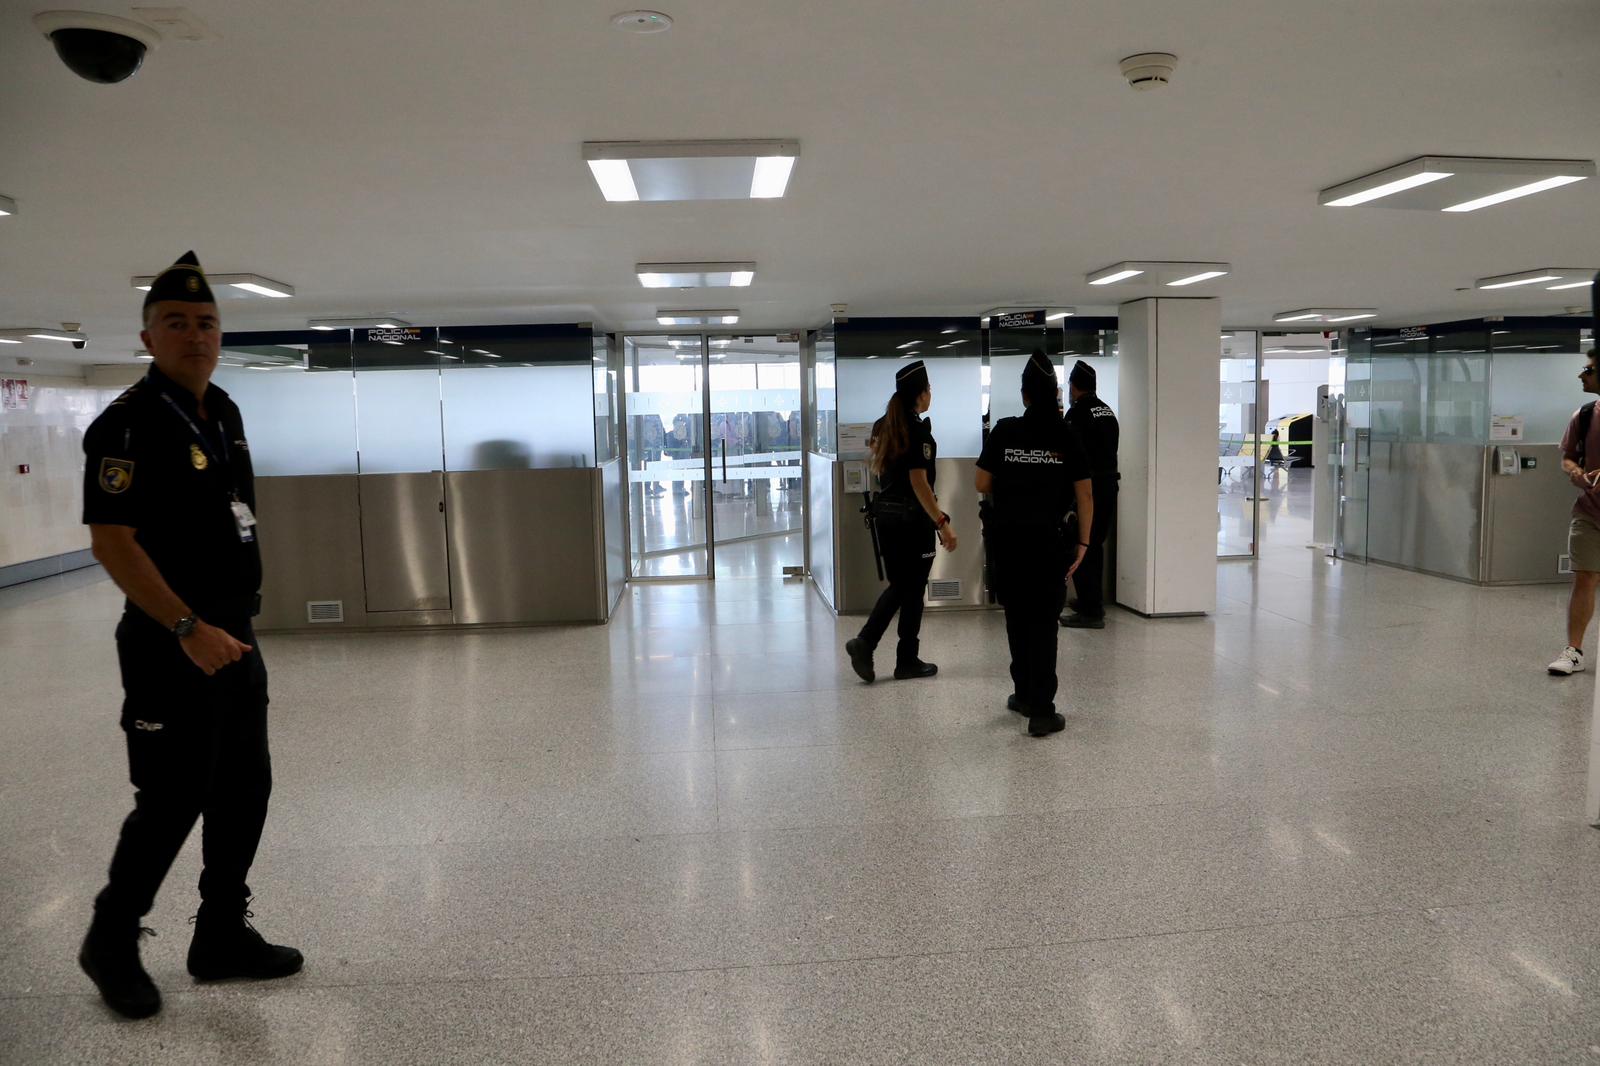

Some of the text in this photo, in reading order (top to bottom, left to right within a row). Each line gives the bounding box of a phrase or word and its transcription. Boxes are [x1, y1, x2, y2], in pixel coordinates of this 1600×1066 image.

[999, 320, 1034, 328] NACIONAL
[1005, 448, 1052, 457] POLICIA
[1005, 455, 1063, 464] NACIONAL
